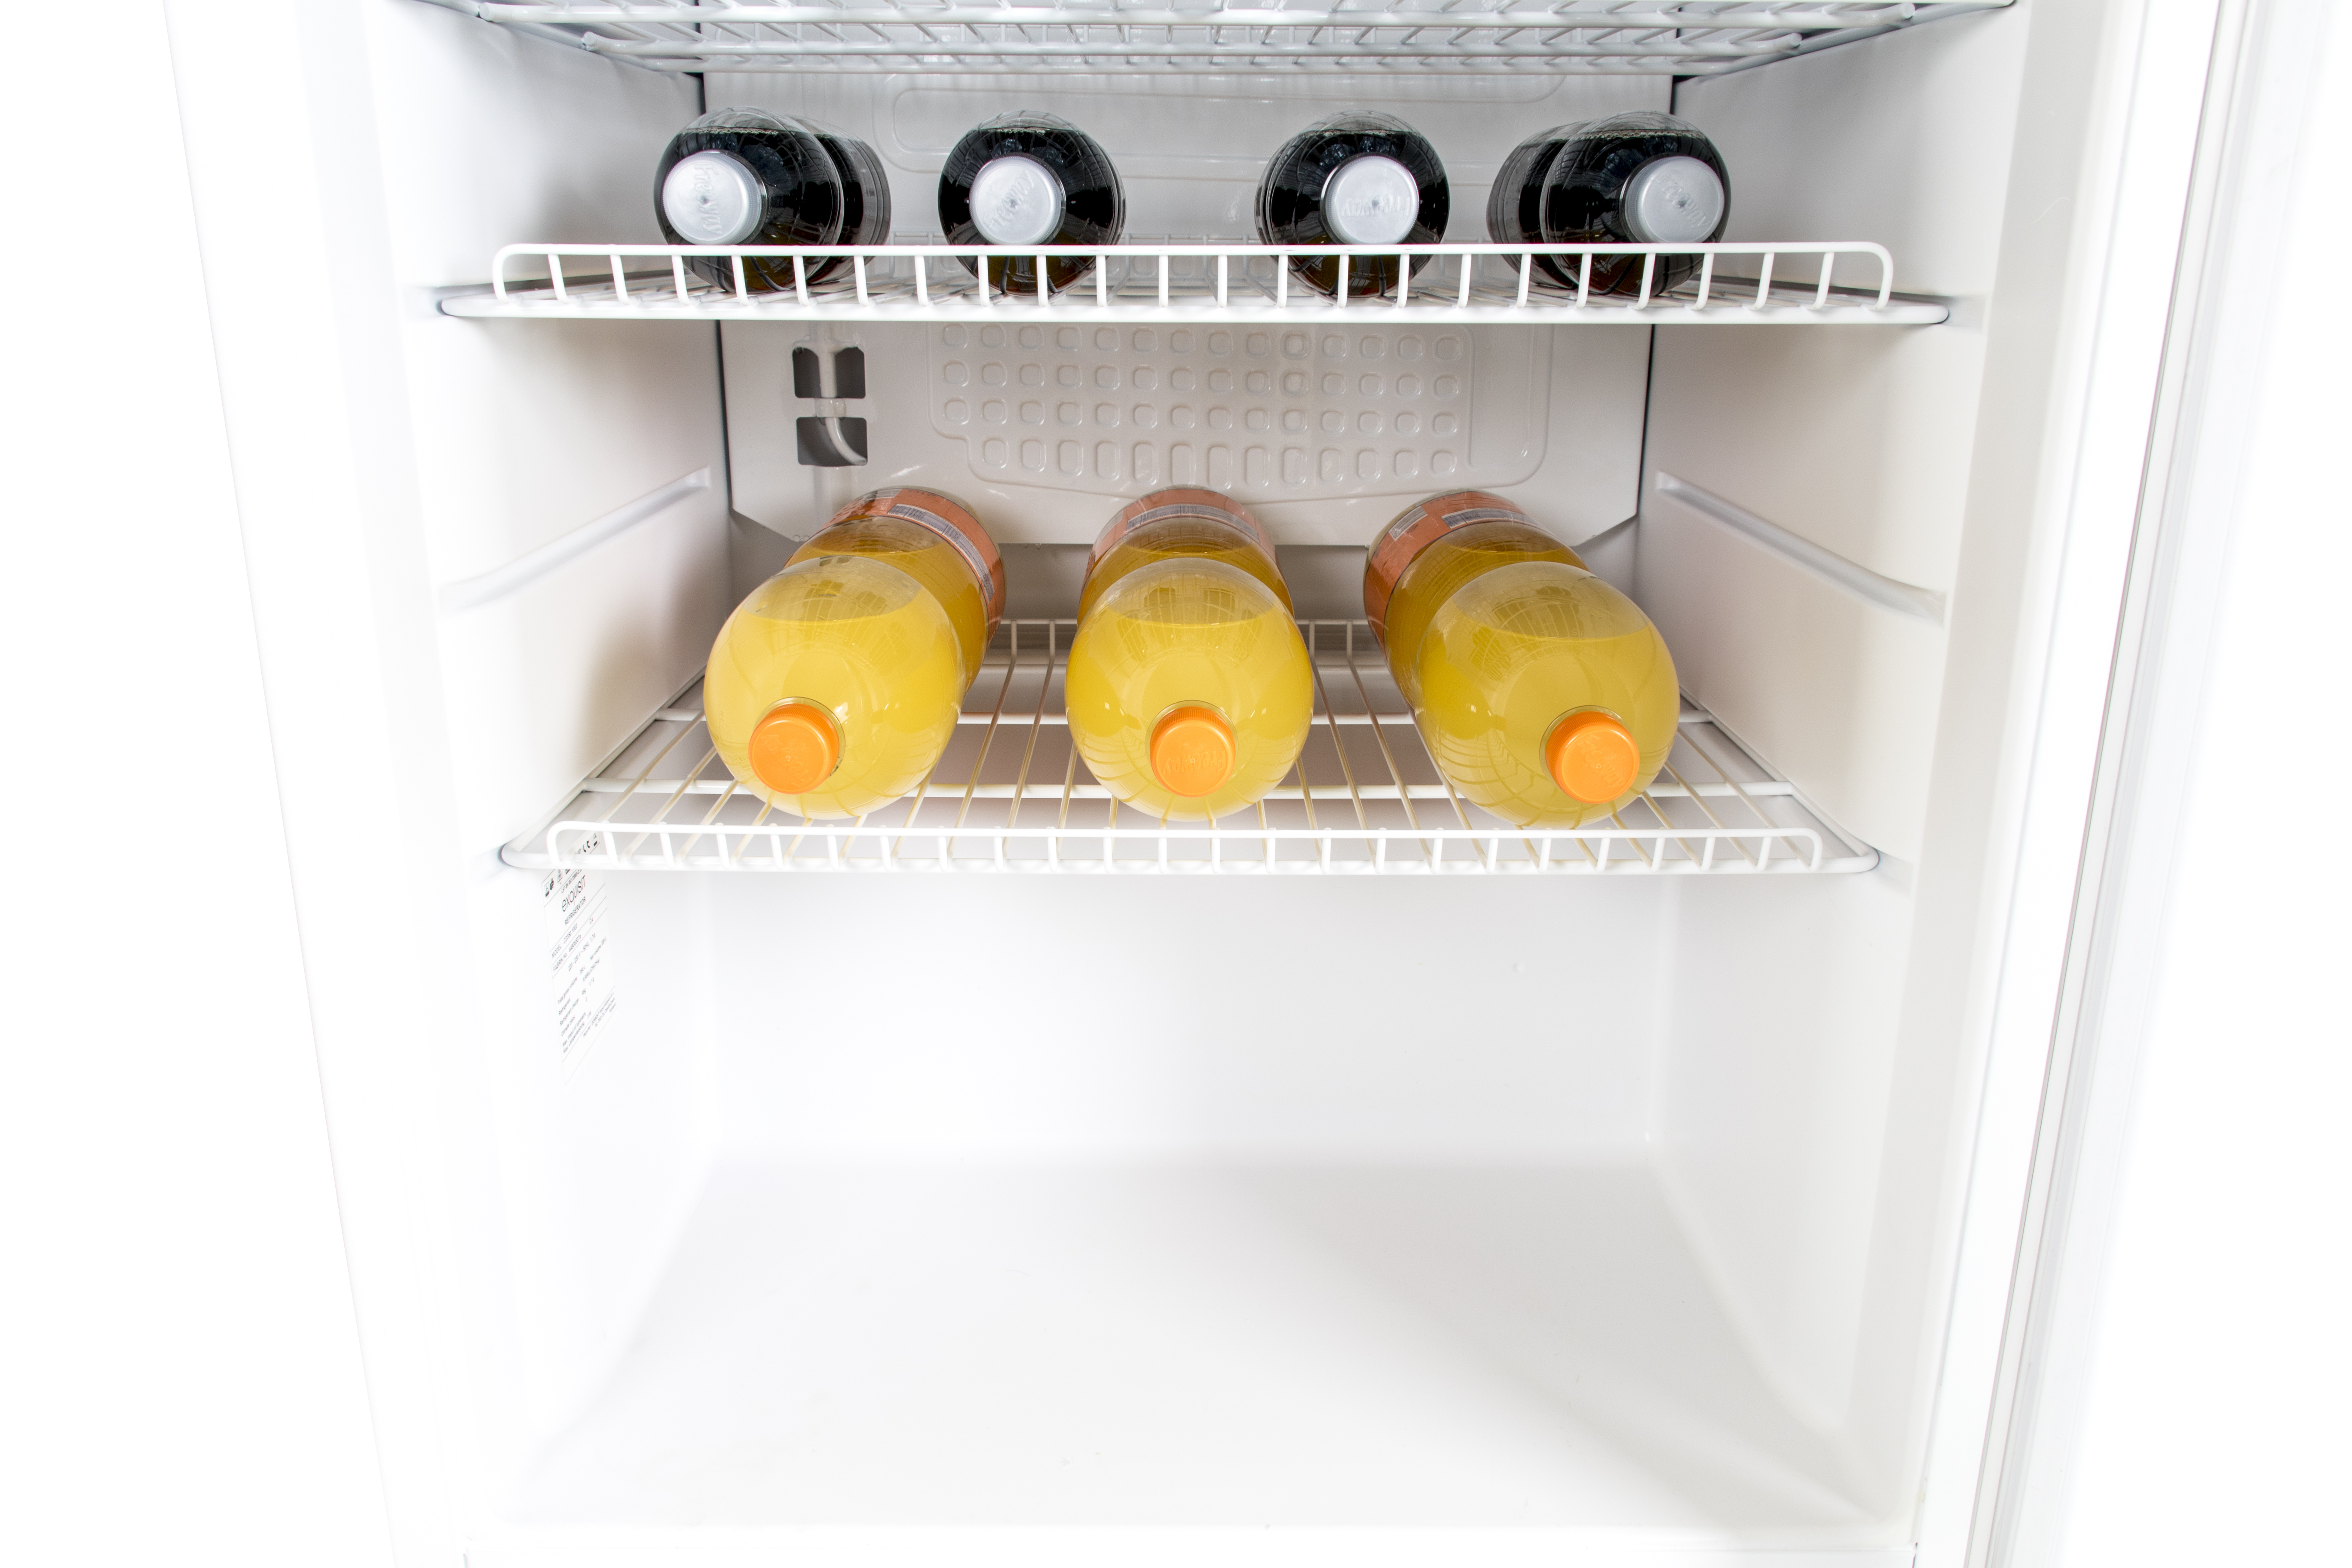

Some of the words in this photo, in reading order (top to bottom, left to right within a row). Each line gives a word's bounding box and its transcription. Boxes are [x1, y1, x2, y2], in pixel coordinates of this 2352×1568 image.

[564, 896, 586, 926] REFRIGERATOR
[558, 997, 570, 1016] Refrigerant
[560, 1008, 572, 1026] Refrigerant
